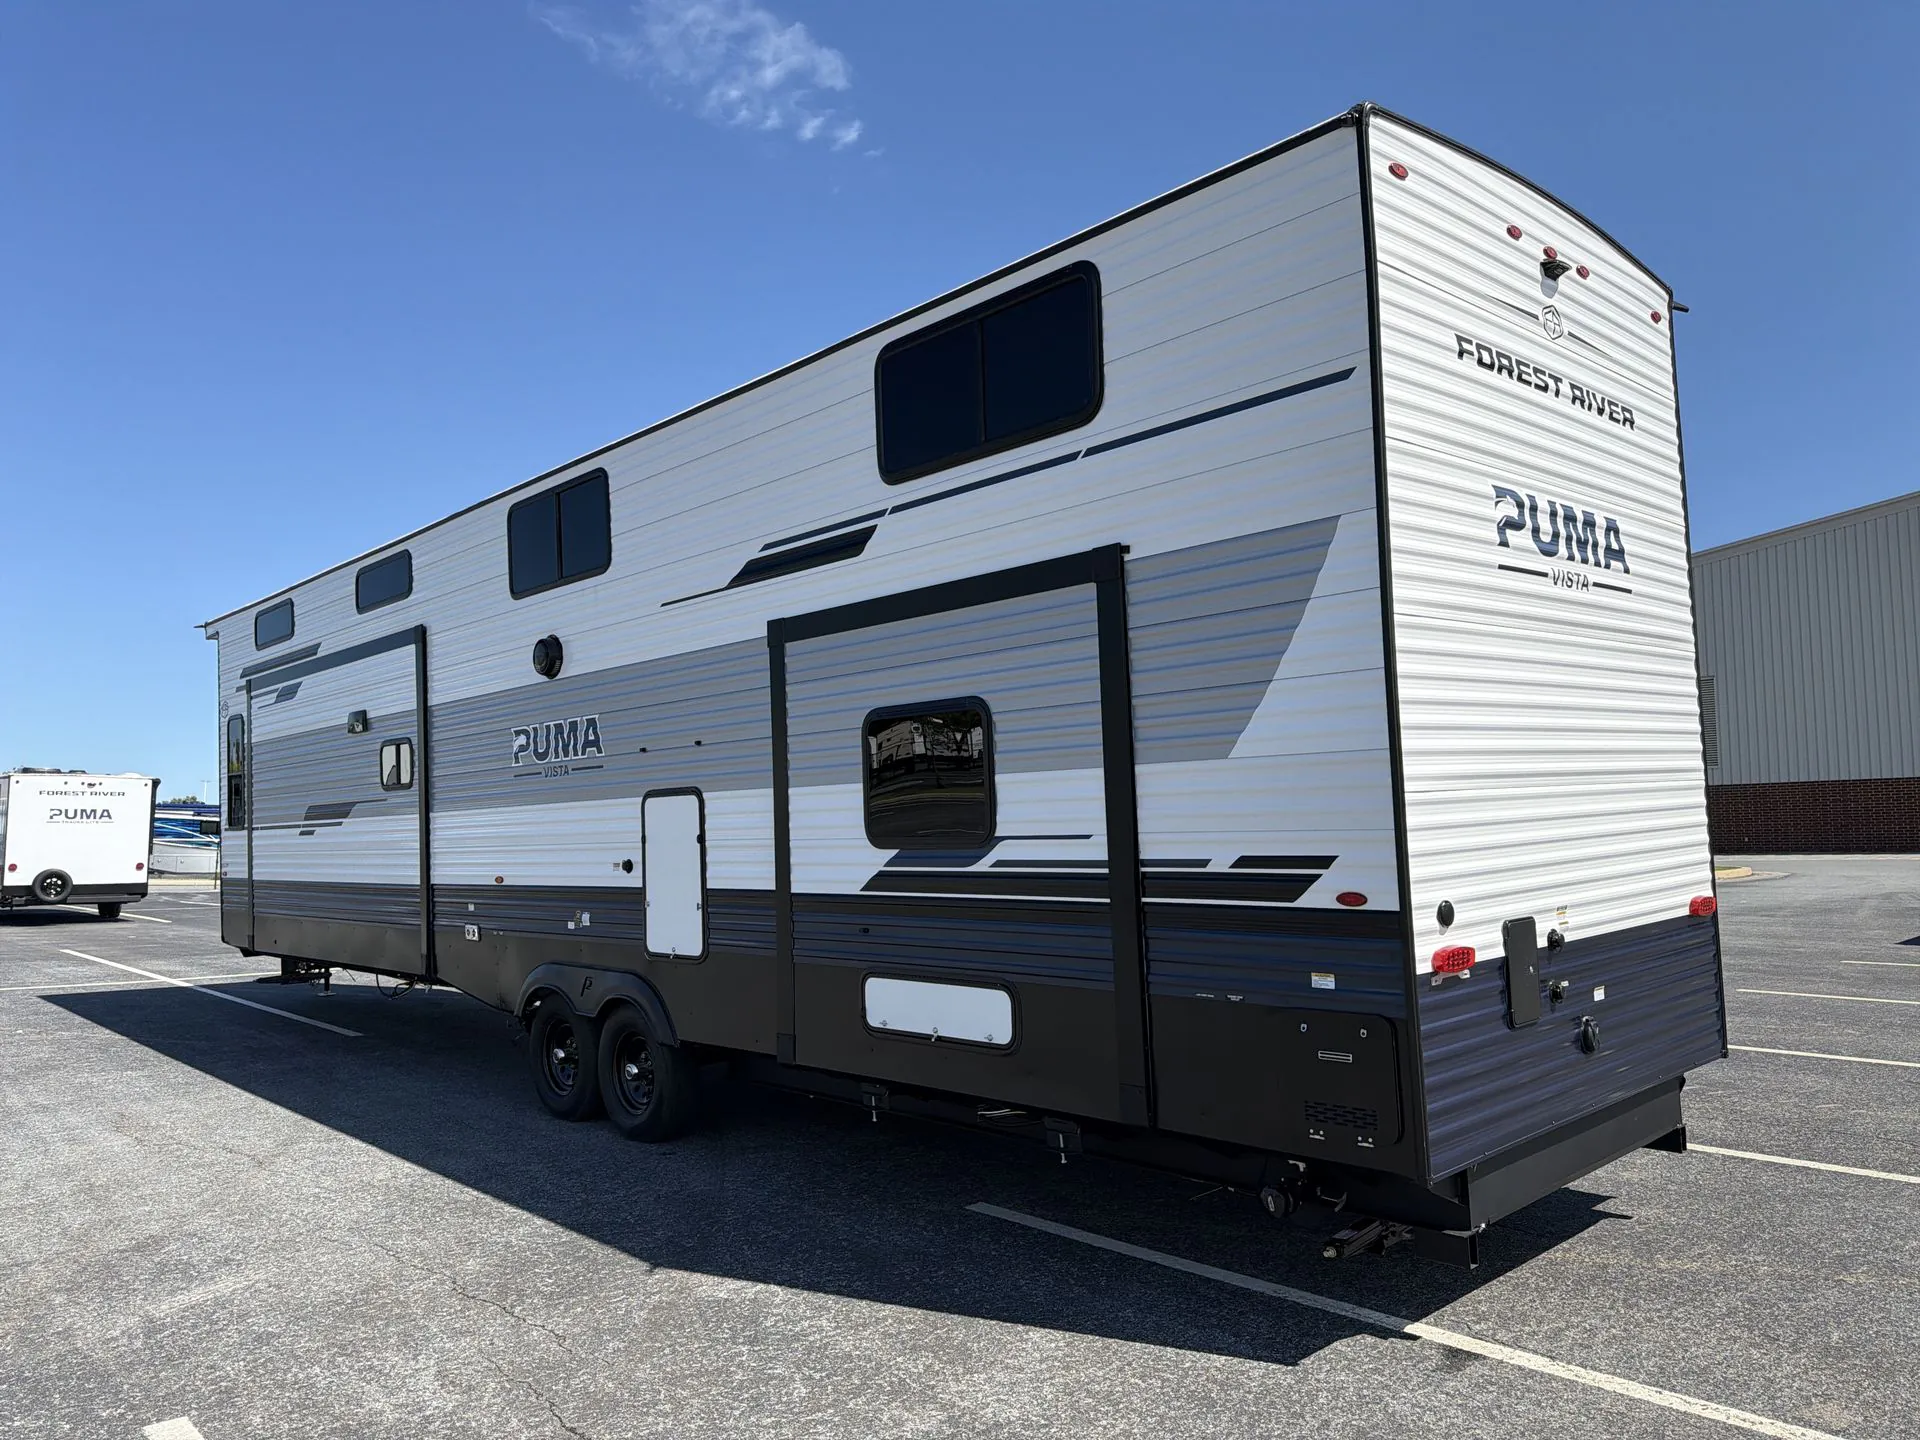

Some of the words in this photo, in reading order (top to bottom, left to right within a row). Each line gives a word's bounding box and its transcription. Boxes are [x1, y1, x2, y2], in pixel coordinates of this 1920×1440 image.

[1454, 333, 1563, 399] FOREST
[1568, 381, 1635, 431] RIVER
[1491, 484, 1630, 574] PUMA
[1551, 568, 1590, 591] VISTA
[511, 714, 605, 766] PUMA
[543, 765, 570, 778] VISTA
[49, 808, 112, 820] PUMA
